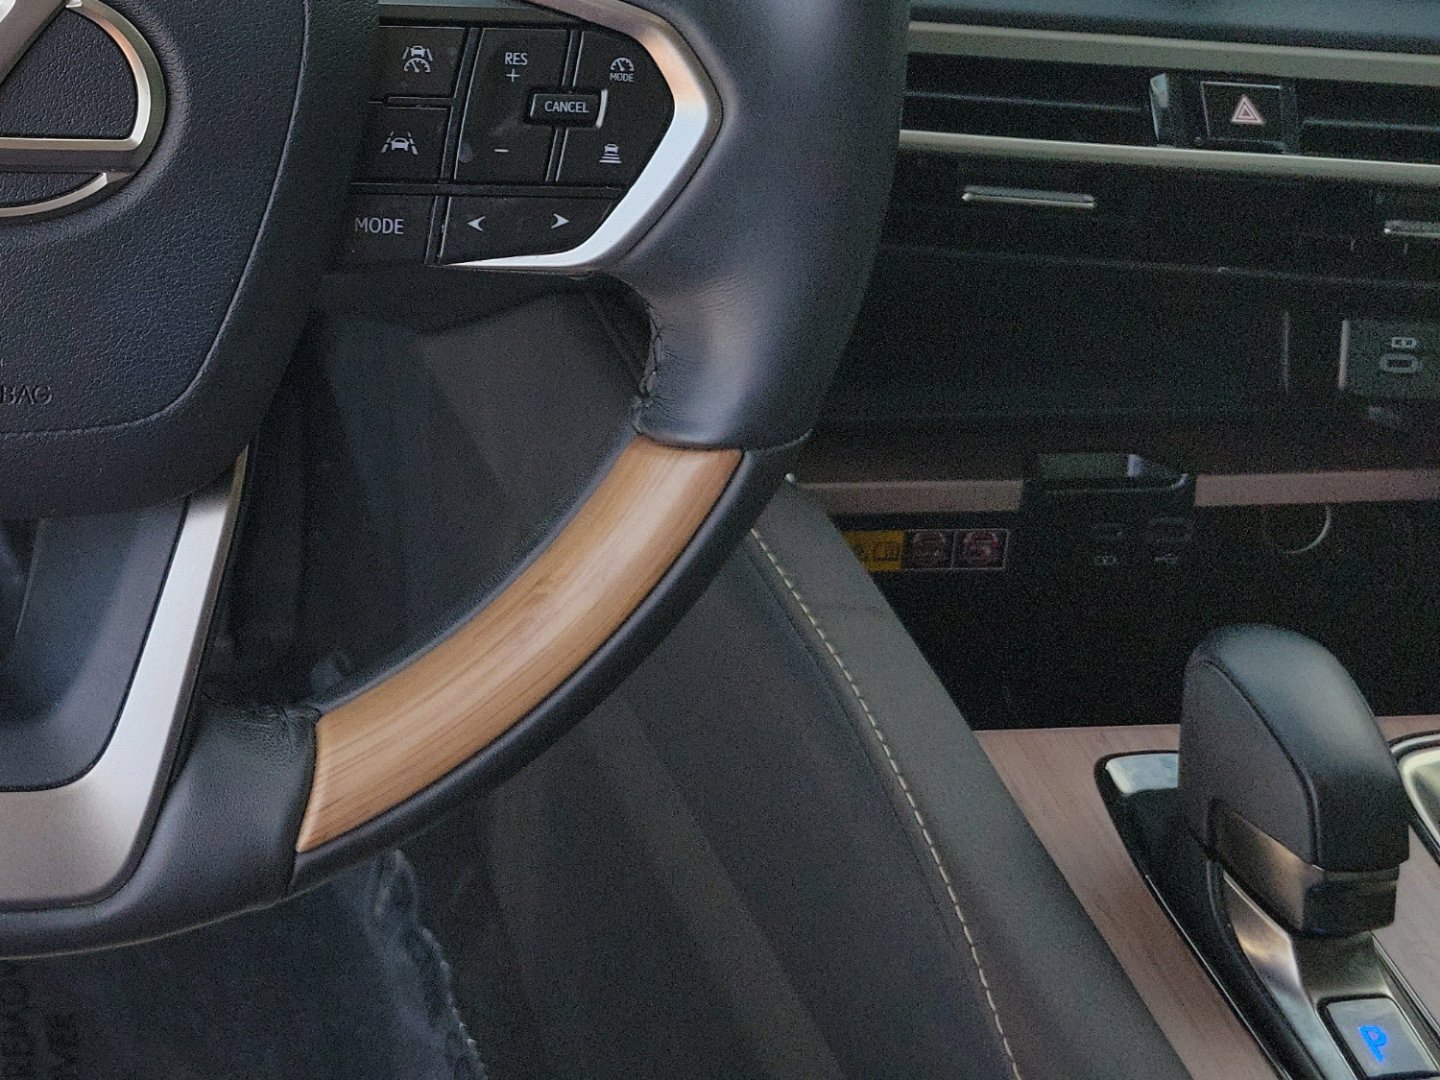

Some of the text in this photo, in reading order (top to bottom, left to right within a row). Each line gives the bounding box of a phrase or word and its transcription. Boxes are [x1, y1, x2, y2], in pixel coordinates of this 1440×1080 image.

[504, 52, 528, 66] RES
[609, 72, 634, 83] MODE
[544, 100, 589, 114] CANCEL
[355, 217, 404, 235] MODE
[1357, 1024, 1389, 1063] P
